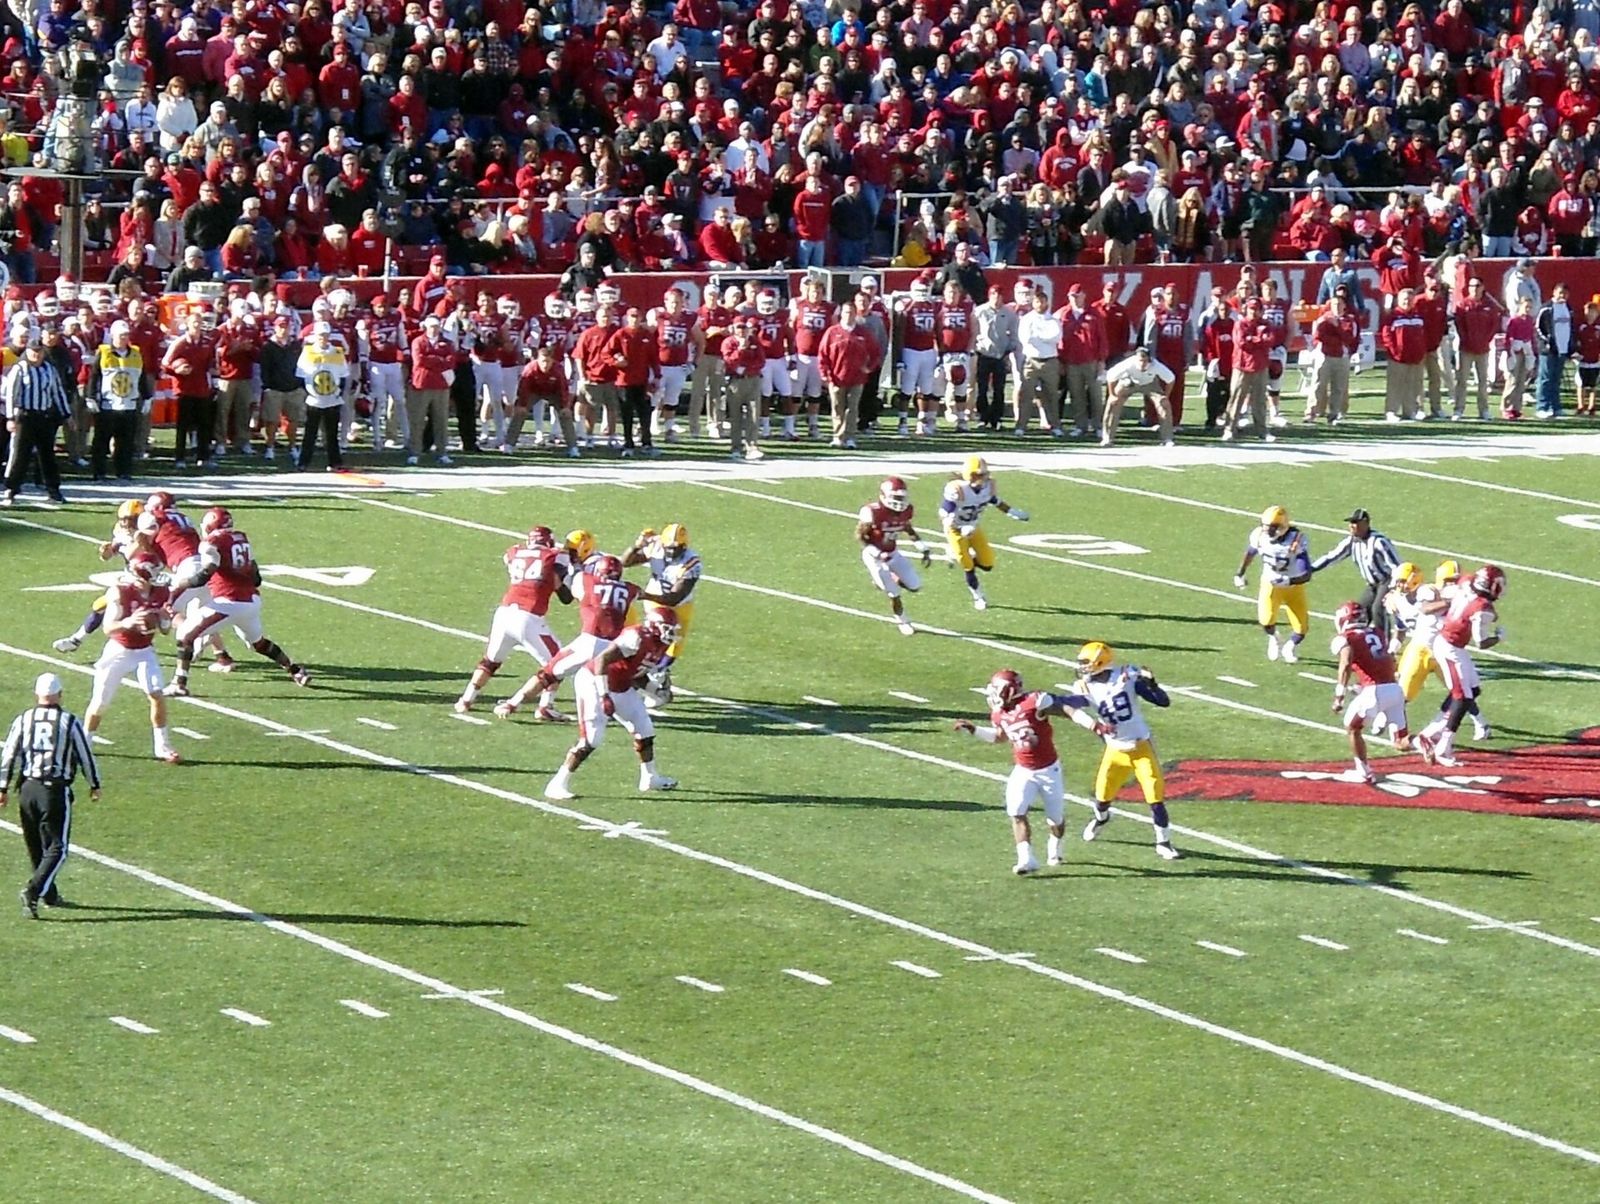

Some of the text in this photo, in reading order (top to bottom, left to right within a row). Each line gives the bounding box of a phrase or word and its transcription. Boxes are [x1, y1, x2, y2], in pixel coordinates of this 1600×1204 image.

[914, 316, 935, 331] 50
[593, 583, 630, 612] 76
[1364, 633, 1384, 660] 2
[1098, 690, 1133, 725] 49
[33, 721, 54, 750] R
